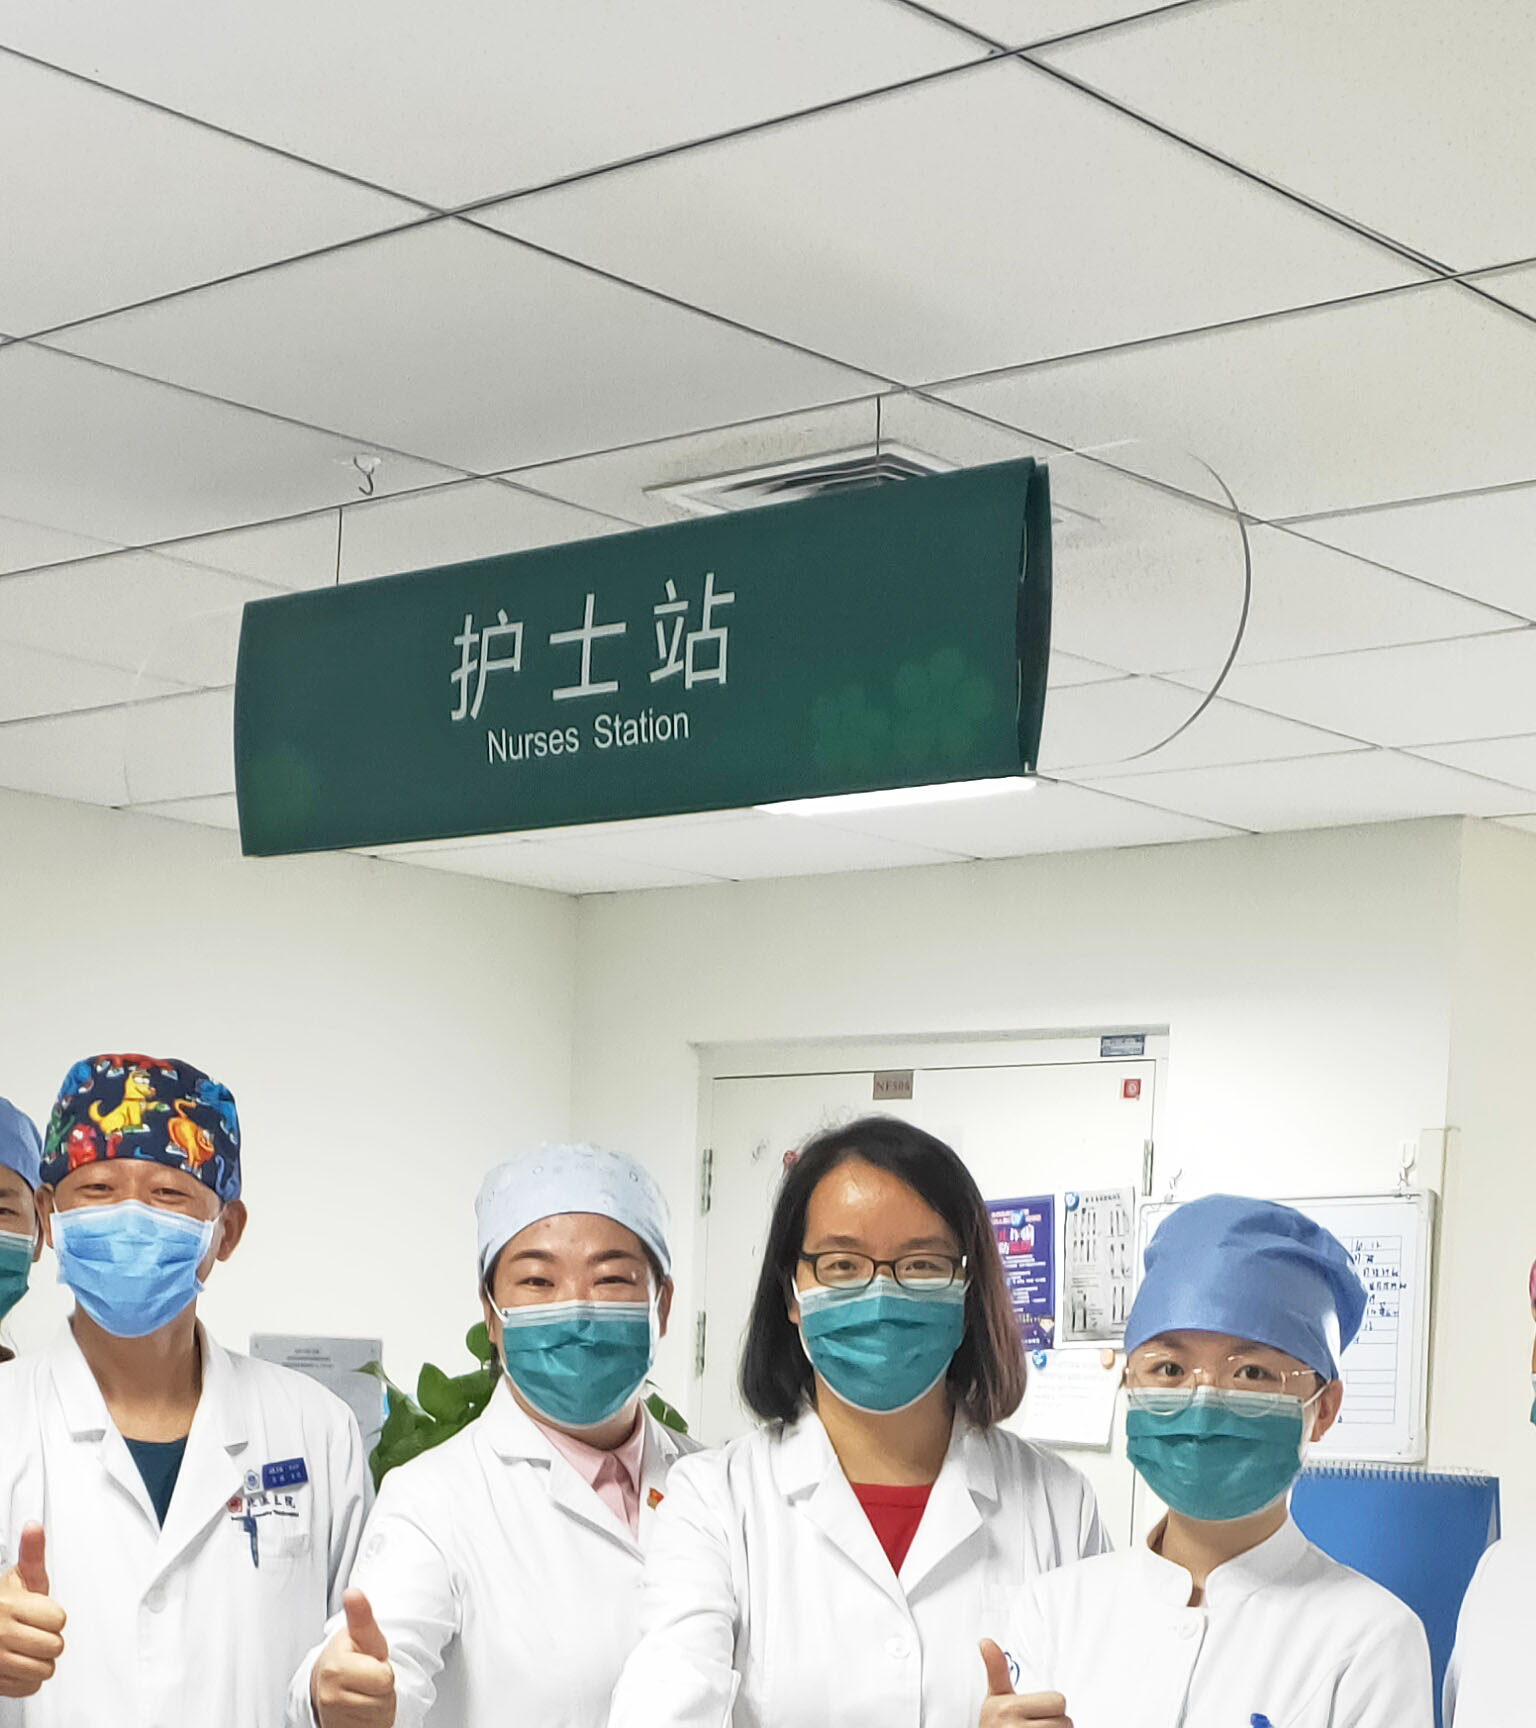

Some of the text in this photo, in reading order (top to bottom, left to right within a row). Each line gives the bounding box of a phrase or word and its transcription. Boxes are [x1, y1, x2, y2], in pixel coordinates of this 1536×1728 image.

[450, 572, 736, 722] 护士站
[487, 706, 690, 764] Nurses Station
